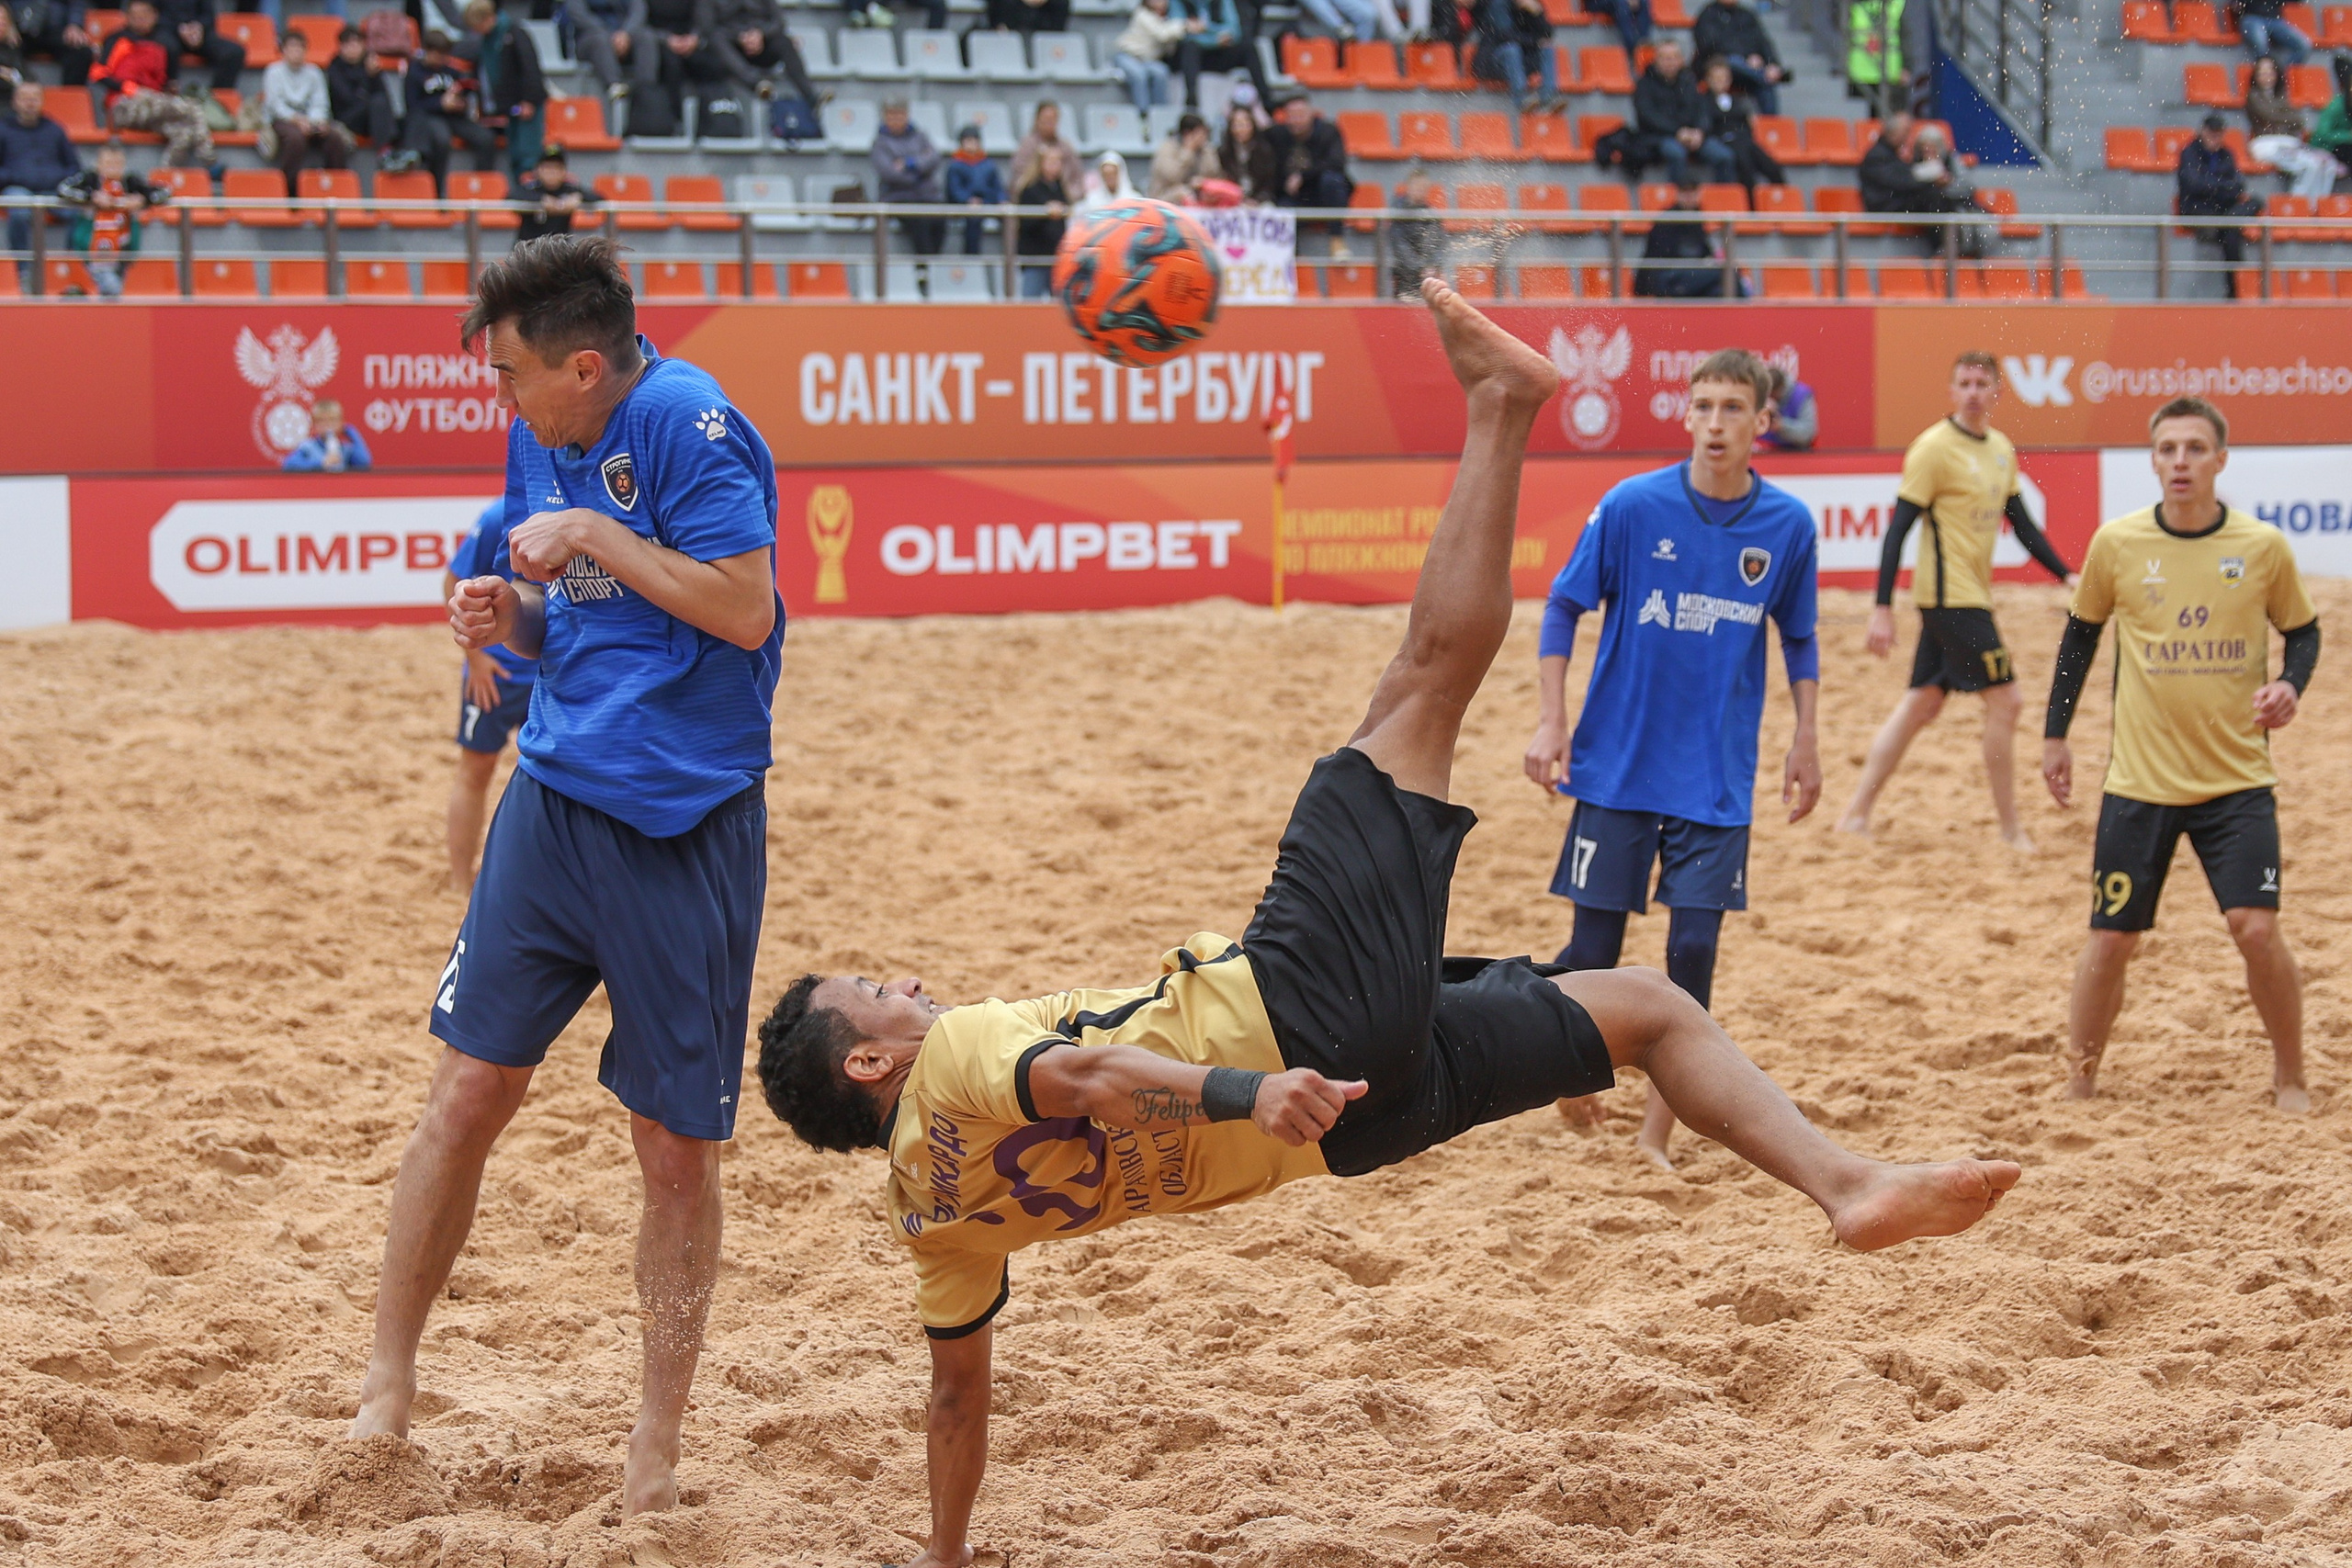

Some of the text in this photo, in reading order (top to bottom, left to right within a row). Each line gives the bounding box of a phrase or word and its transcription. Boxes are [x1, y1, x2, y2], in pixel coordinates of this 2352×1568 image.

[799, 352, 1325, 425] САНКТ-ПЕТЕРБУРГ
[364, 397, 508, 434] ФУТБОЛ
[2256, 502, 2352, 535] НОВ
[185, 533, 465, 574] OLIMPB
[879, 520, 1242, 576] OLIMPBET
[564, 576, 624, 604] СПОРТ
[1674, 611, 1720, 636] СПОРТ
[1677, 592, 1765, 626] МОСКОВСКИЙ
[2177, 605, 2210, 629] 69
[2145, 639, 2246, 662] САРАТОВ
[1571, 835, 1598, 889] 17
[2095, 869, 2132, 917] 69
[1131, 1087, 1206, 1126] Felipe
